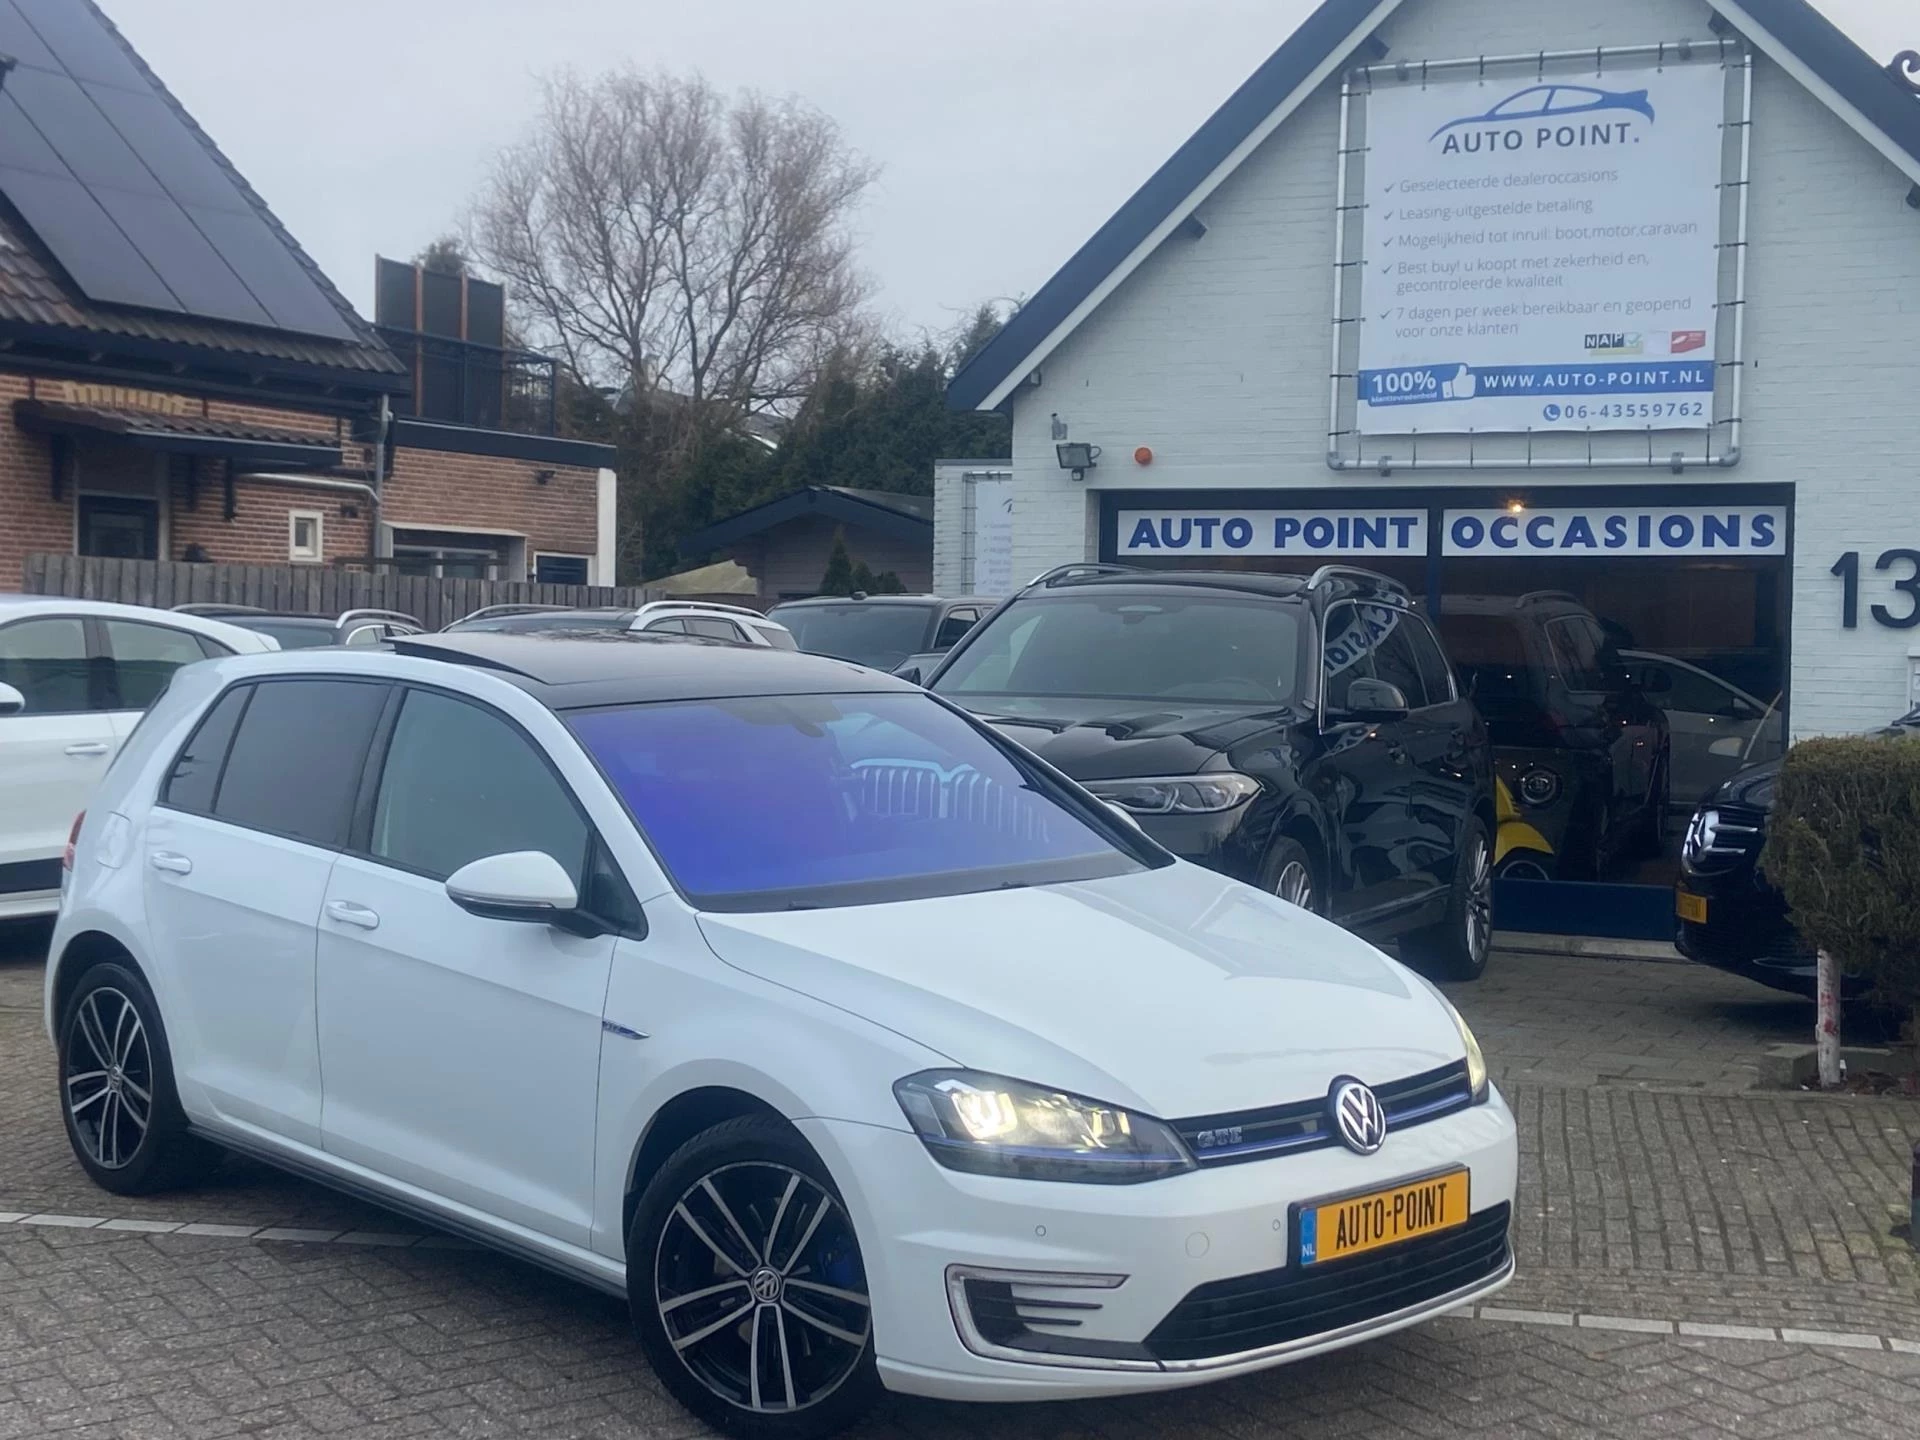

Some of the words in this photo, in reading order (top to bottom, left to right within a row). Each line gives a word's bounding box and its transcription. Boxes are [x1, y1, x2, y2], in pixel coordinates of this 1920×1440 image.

[1442, 129, 1523, 155] AUTO
[1400, 174, 1499, 193] Geselecteerde
[1503, 169, 1618, 188] dealeroccasions
[1536, 198, 1593, 215] betaling
[1399, 229, 1485, 250] Mogelijkheid
[1488, 231, 1509, 242] tot
[1397, 262, 1427, 274] Best
[1464, 263, 1473, 272] u
[1477, 258, 1517, 273] koopt
[1521, 257, 1548, 269] met
[1552, 252, 1623, 268] zekerheid
[1395, 276, 1502, 297] gecontroleerde
[1506, 274, 1563, 288] kwaliteit
[1396, 308, 1404, 319] 7
[1408, 305, 1450, 322] dagen
[1454, 305, 1478, 321] per
[1481, 303, 1518, 317] week
[1522, 300, 1600, 316] bereikbaar
[1603, 302, 1622, 312] en
[1625, 297, 1692, 315] geopend
[1395, 327, 1424, 338] voor
[1429, 325, 1464, 337] onze
[1467, 321, 1519, 336] klanten
[1584, 333, 1625, 349] NAP
[1372, 370, 1437, 394] 100%
[1484, 370, 1705, 389] WWW.AUTO-POINT.NL
[1564, 402, 1704, 419] 06-43559762
[1128, 518, 1253, 548] AUTO
[1275, 516, 1418, 549] POINT
[1450, 514, 1776, 548] OCCASIONS
[1830, 549, 1920, 629] 13
[1197, 1126, 1242, 1148] GTE
[1336, 1183, 1447, 1250] AUTO-POINT
[1302, 1243, 1316, 1257] NL
